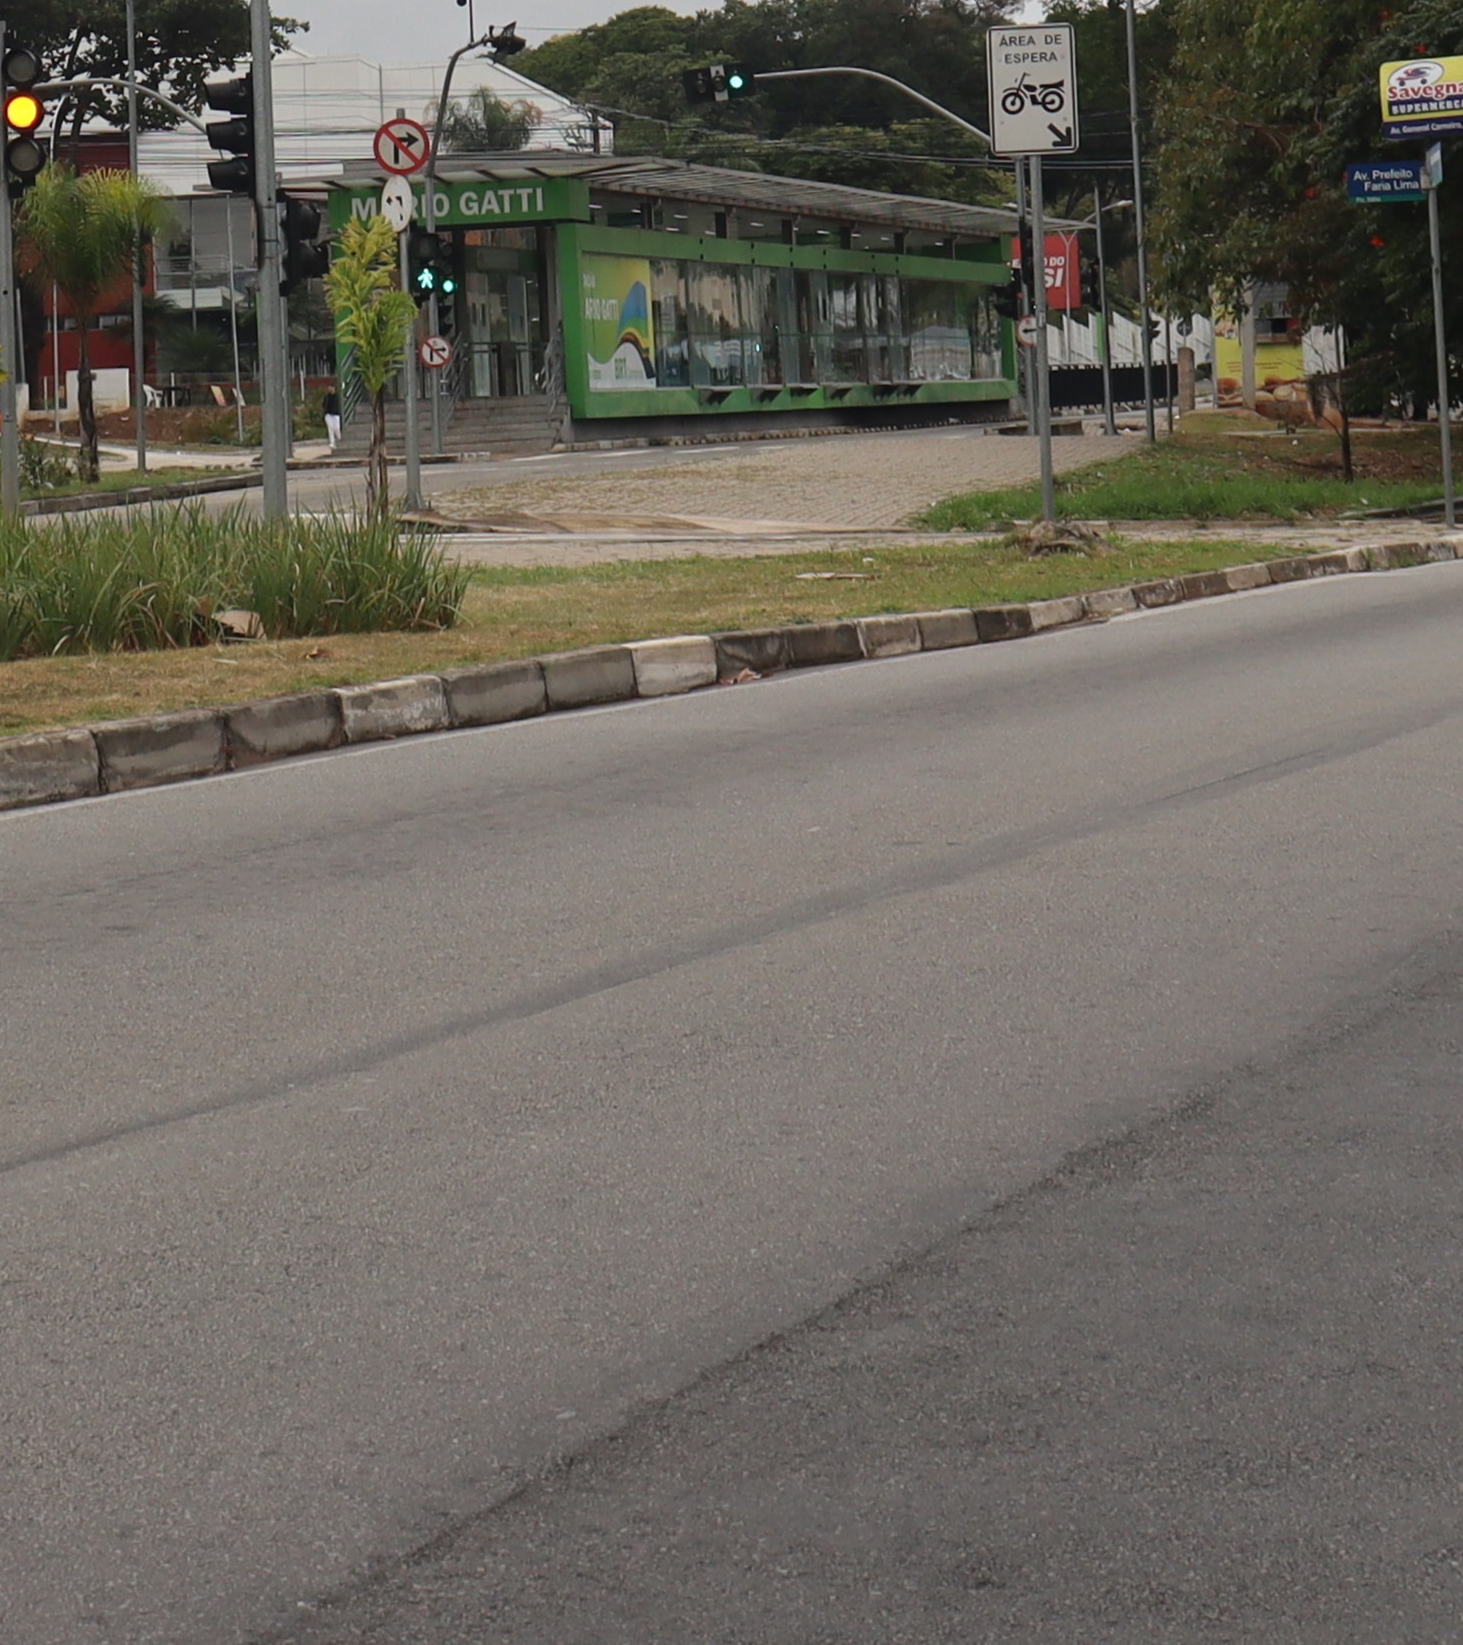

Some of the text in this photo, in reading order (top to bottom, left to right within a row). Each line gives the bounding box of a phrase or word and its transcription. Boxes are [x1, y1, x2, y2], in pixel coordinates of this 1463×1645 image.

[999, 34, 1062, 47] ÁREA DE
[1004, 51, 1058, 64] ESPERA
[1353, 168, 1413, 181] Av. Prefeito
[1364, 179, 1419, 192] Faria Lima
[351, 187, 544, 222] MRIO GATTI
